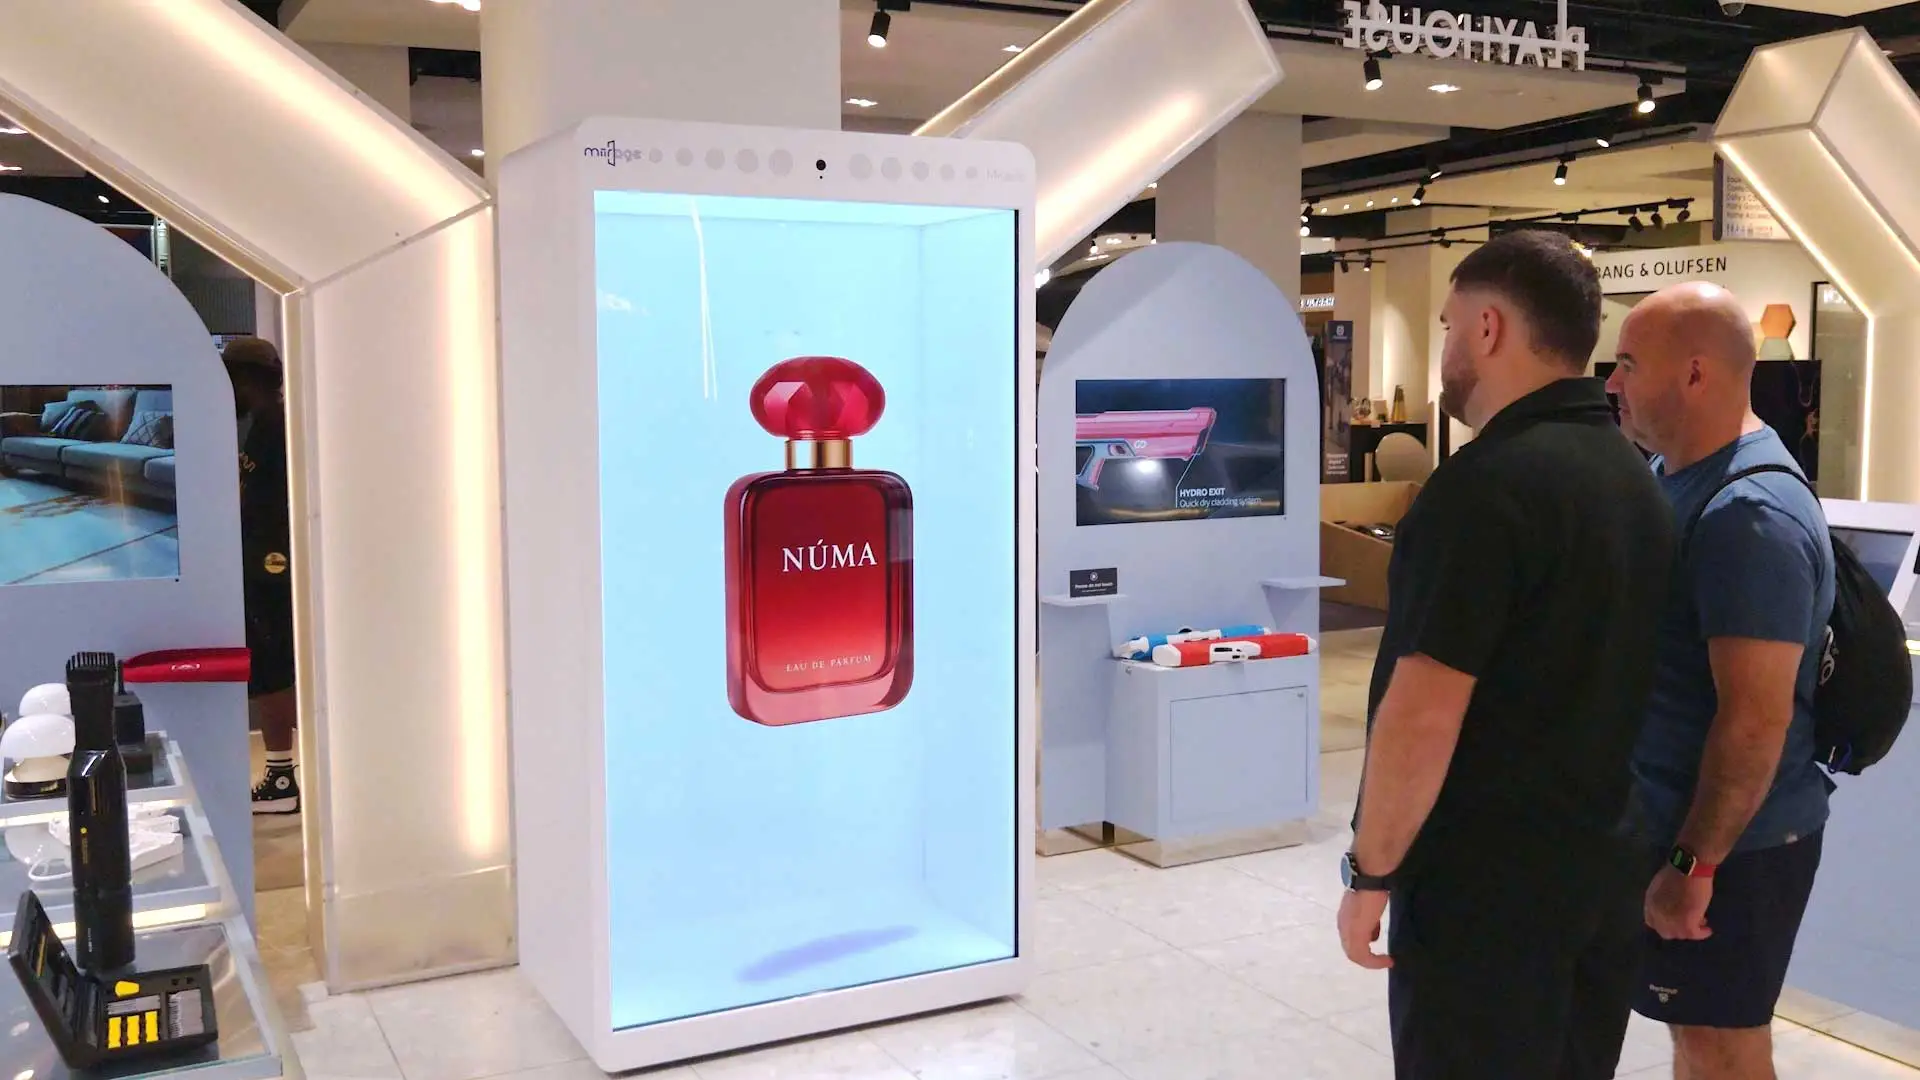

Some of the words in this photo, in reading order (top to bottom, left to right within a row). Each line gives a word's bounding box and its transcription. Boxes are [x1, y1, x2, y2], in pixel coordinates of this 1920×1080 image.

[1640, 262, 1649, 277] &
[1653, 256, 1727, 276] OLUFSEN
[1180, 488, 1208, 497] HYDRO
[1208, 487, 1225, 496] EXIT
[1180, 499, 1199, 508] Quick
[1200, 498, 1210, 508] dry
[782, 538, 878, 572] NÚMA
[786, 662, 808, 673] EAU
[811, 659, 825, 670] DE
[830, 654, 872, 668] PARFUM
